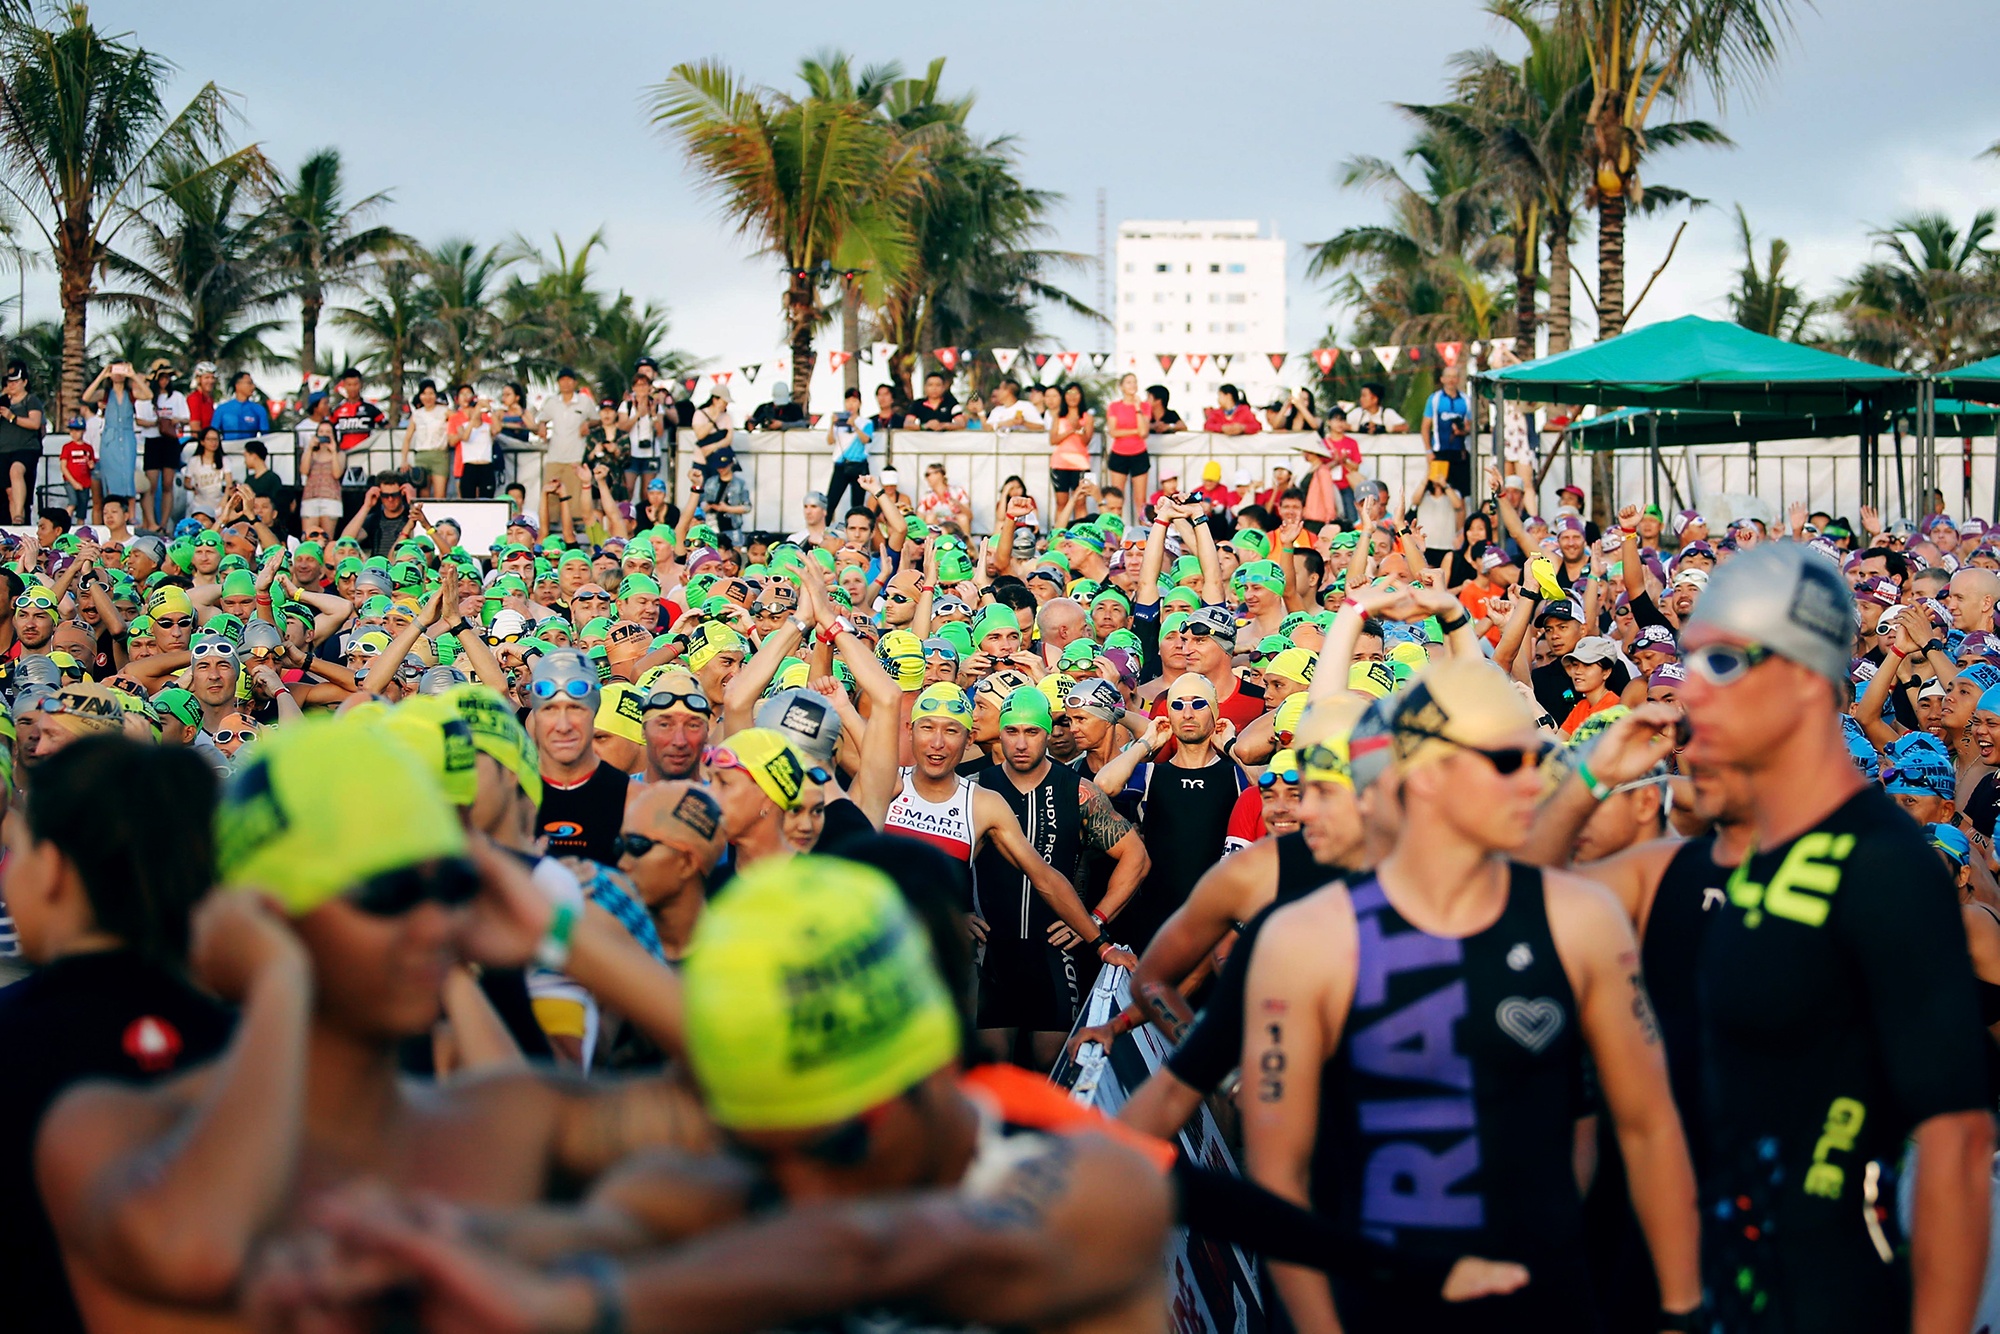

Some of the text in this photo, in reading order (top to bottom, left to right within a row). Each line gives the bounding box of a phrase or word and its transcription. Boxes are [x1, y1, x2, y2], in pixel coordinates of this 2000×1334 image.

[1181, 779, 1205, 789] TYR
[891, 805, 964, 830] SMART
[1045, 785, 1057, 829] RUDY
[888, 815, 963, 838] COACHING
